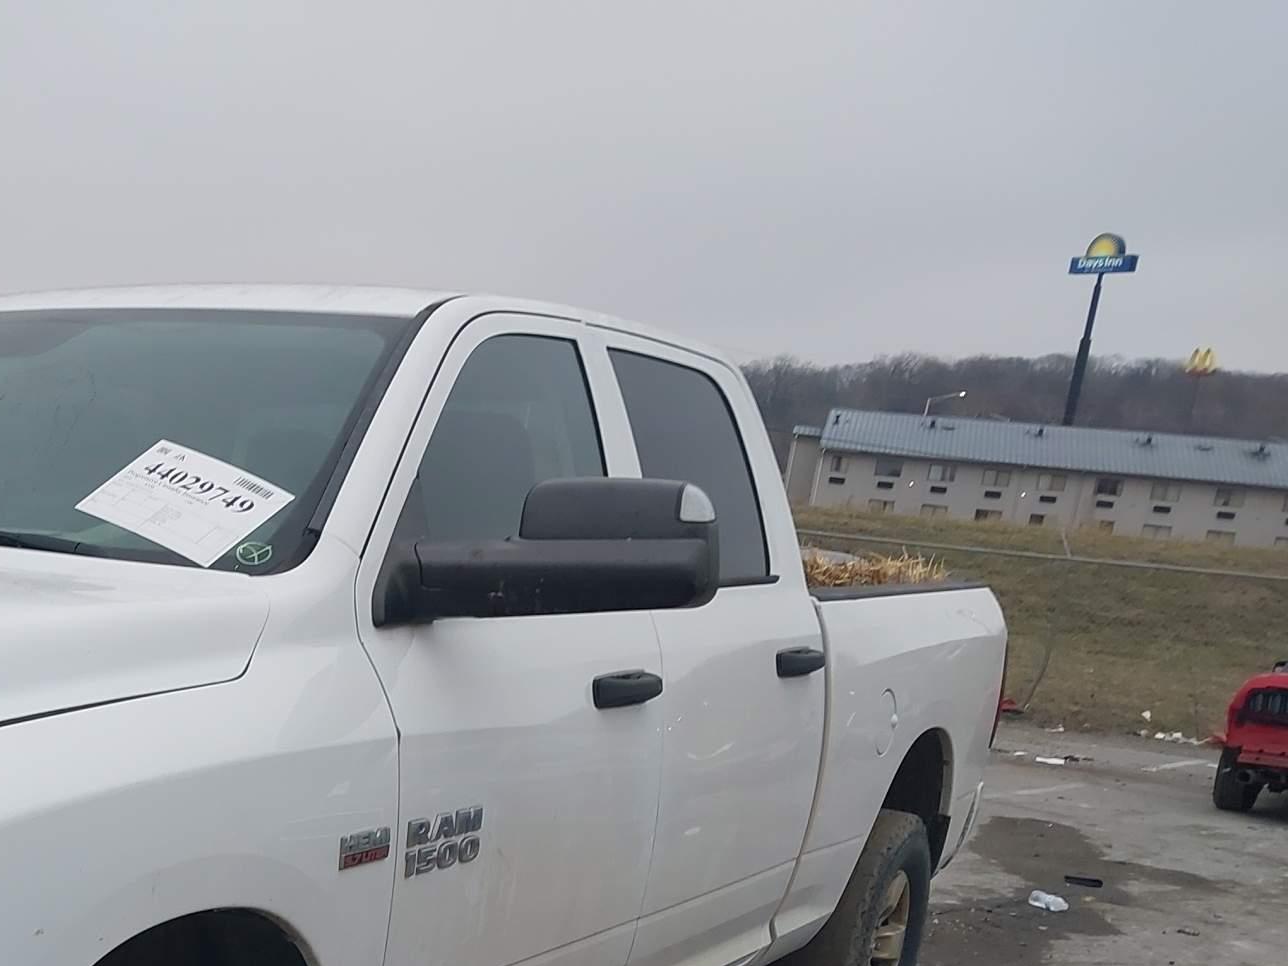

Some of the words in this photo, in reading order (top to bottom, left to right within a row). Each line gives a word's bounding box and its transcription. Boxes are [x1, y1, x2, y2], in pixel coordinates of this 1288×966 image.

[144, 462, 255, 513] 44029749
[340, 827, 391, 853] HEMI
[406, 805, 484, 849] RAM
[404, 834, 481, 880] 1500
